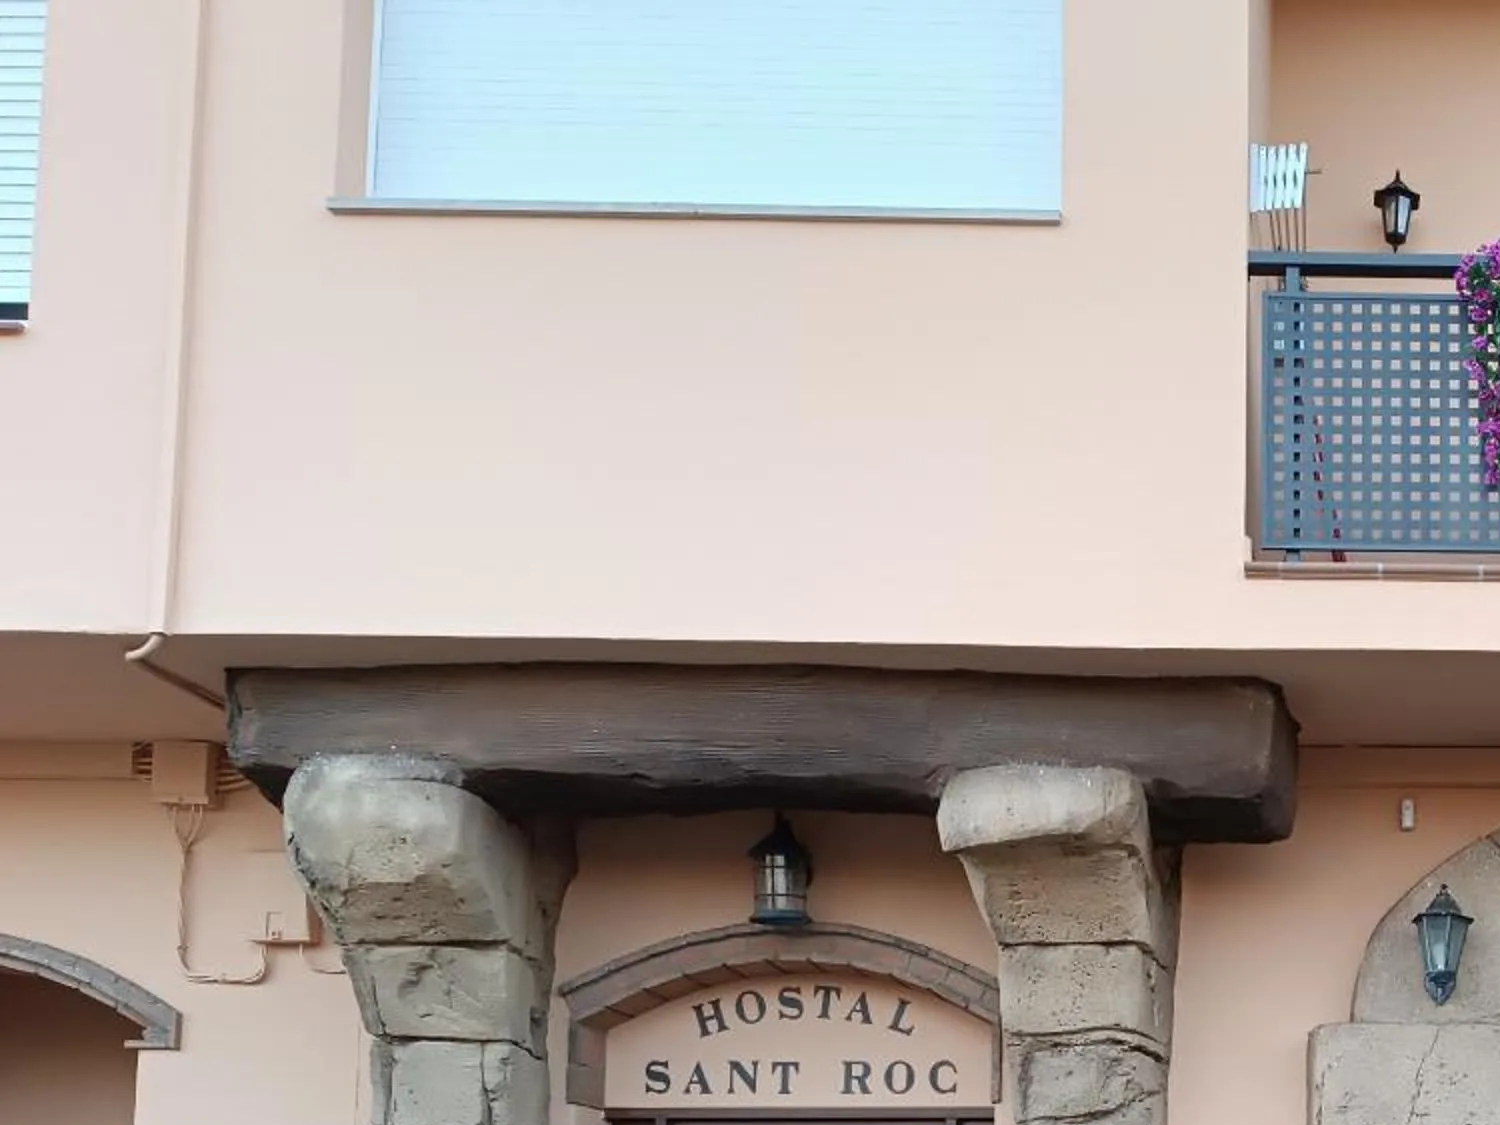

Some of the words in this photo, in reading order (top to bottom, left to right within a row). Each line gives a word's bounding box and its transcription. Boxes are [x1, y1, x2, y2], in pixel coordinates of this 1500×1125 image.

[692, 985, 915, 1037] HOSTAL
[645, 1060, 800, 1095] SANT
[841, 1060, 958, 1095] ROC
